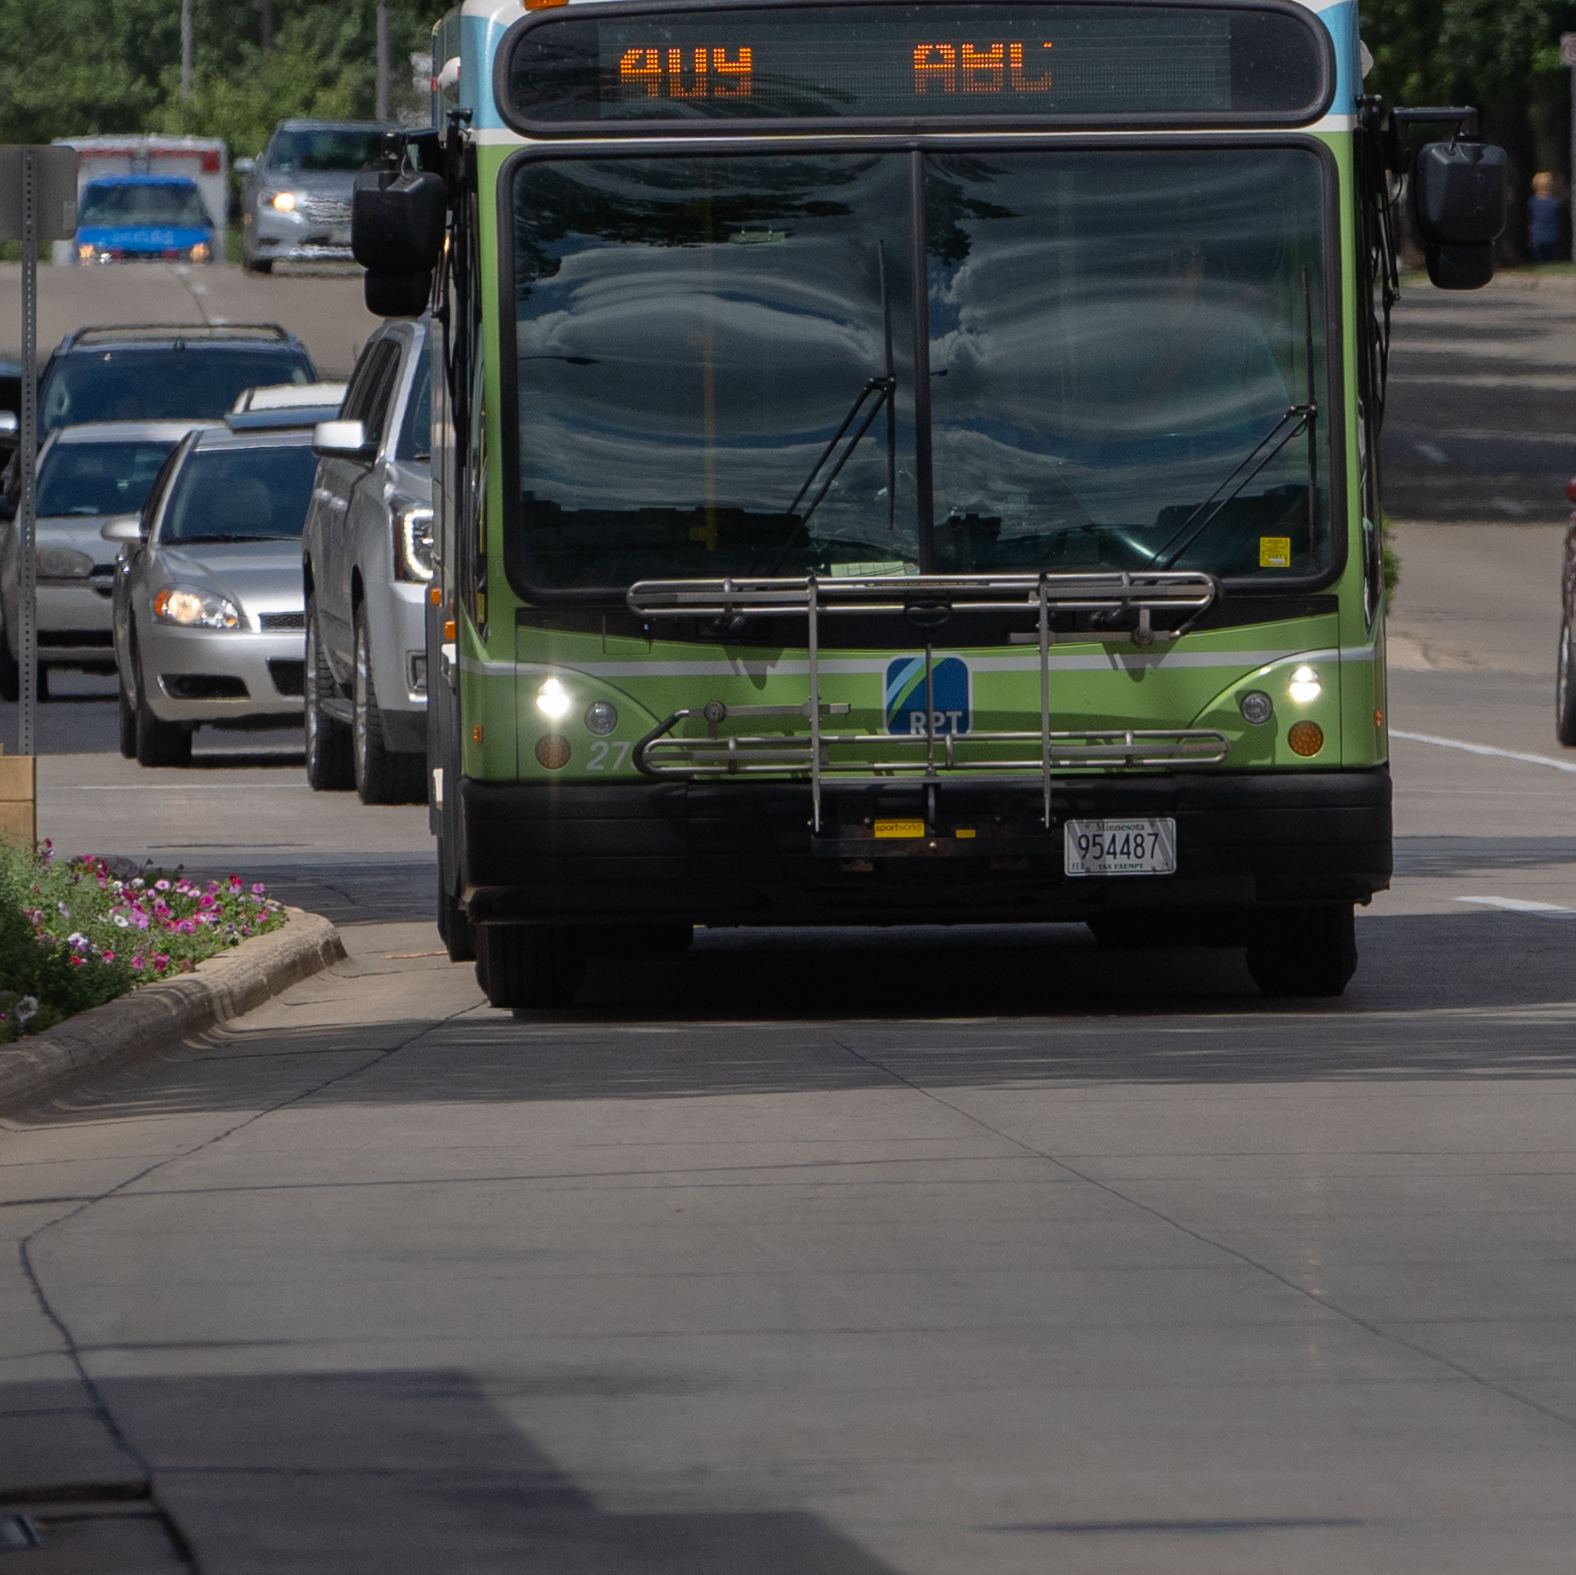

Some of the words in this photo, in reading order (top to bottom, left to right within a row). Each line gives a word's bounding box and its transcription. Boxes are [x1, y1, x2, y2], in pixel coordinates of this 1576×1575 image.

[909, 710, 964, 735] RPT
[585, 740, 638, 772] 27
[1095, 821, 1146, 832] Minnesota
[1077, 832, 1160, 861] 954487
